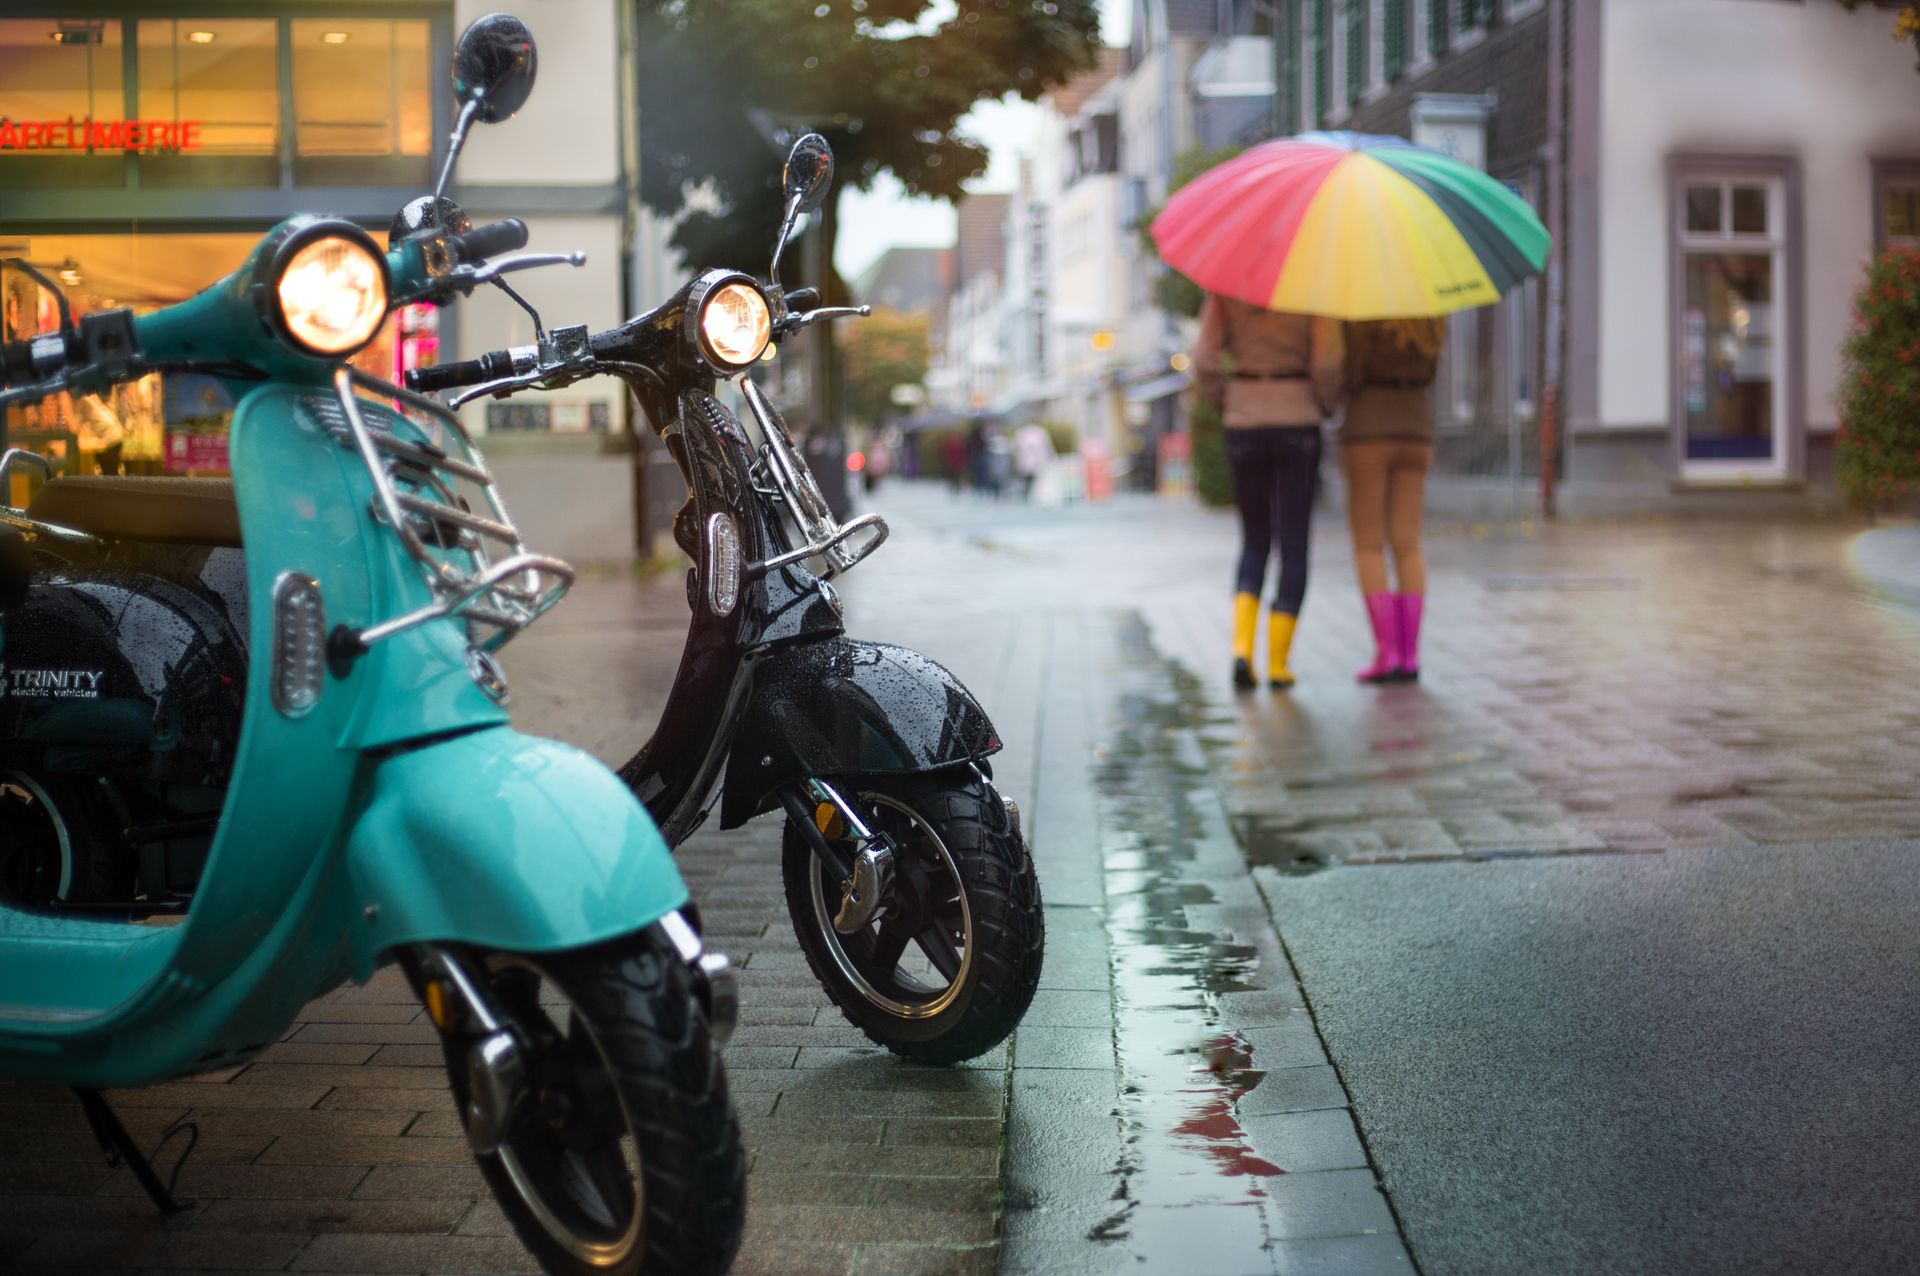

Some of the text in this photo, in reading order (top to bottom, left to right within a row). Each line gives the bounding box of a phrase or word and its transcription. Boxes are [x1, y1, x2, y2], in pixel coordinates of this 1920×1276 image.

[10, 669, 103, 688] TRINITY
[11, 688, 97, 698] electric vehicles
